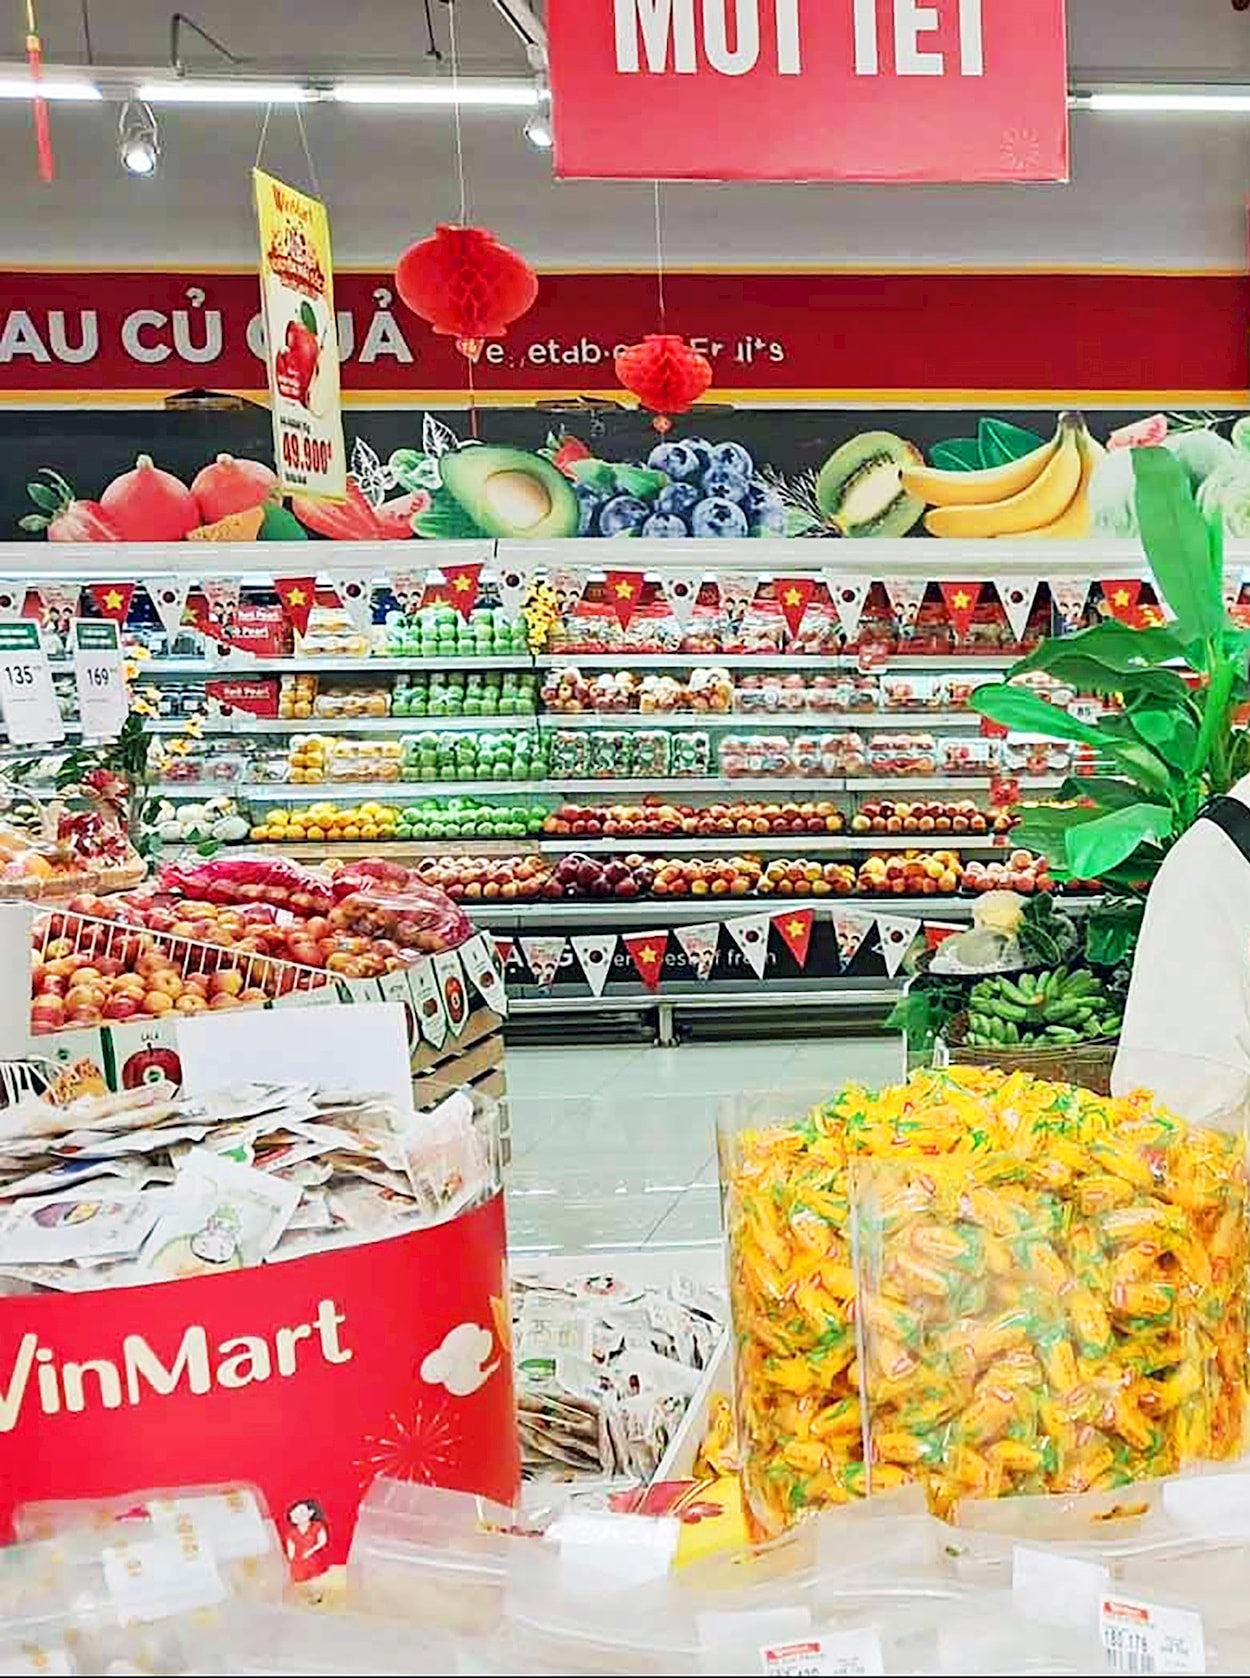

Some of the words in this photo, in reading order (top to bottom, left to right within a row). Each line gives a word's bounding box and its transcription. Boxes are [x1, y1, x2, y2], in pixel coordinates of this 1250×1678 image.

[121, 287, 222, 363] CỦ
[4, 666, 34, 685] 135
[86, 667, 109, 686] 169
